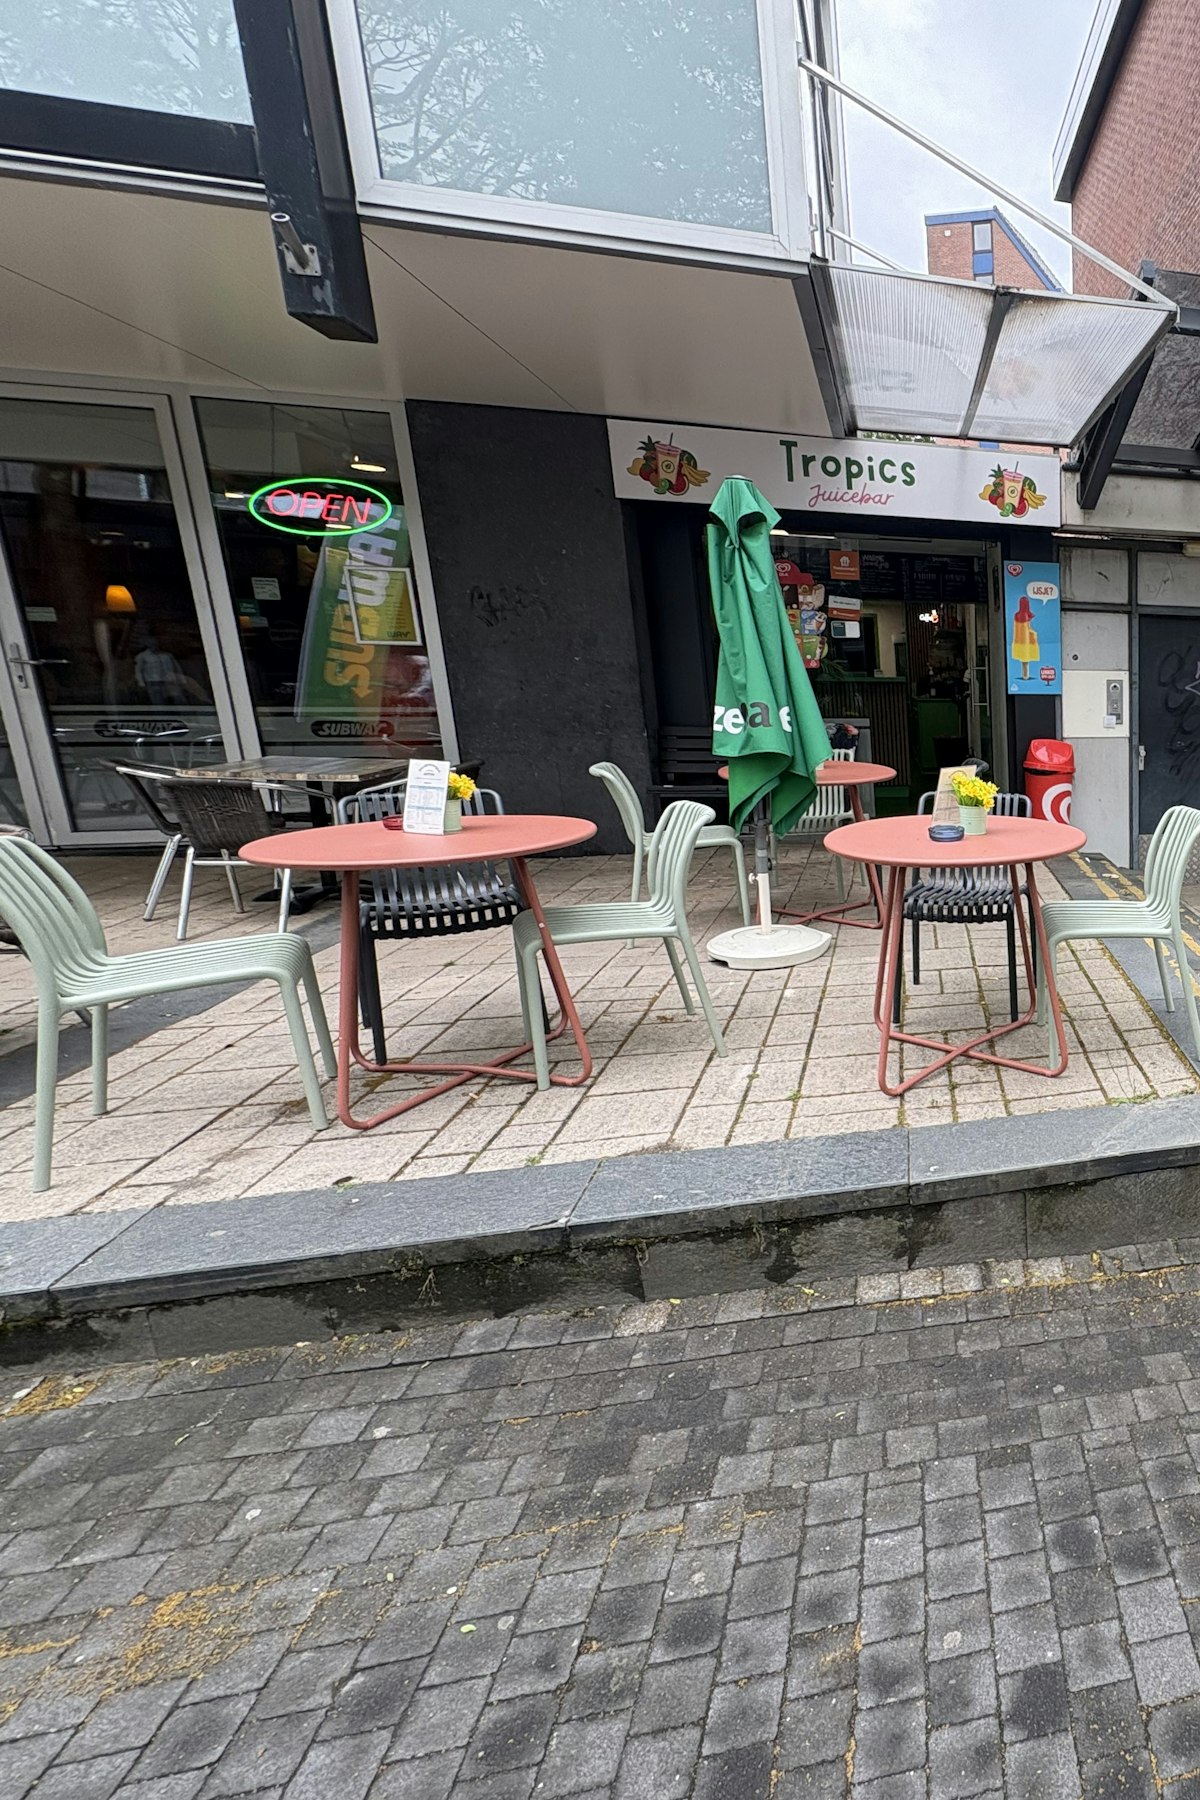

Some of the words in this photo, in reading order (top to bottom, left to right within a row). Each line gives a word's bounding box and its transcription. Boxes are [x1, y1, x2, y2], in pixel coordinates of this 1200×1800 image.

[779, 440, 916, 490] Tropics
[267, 489, 371, 523] OPEN
[808, 483, 895, 508] Juicebar
[319, 721, 385, 736] SUBWAY
